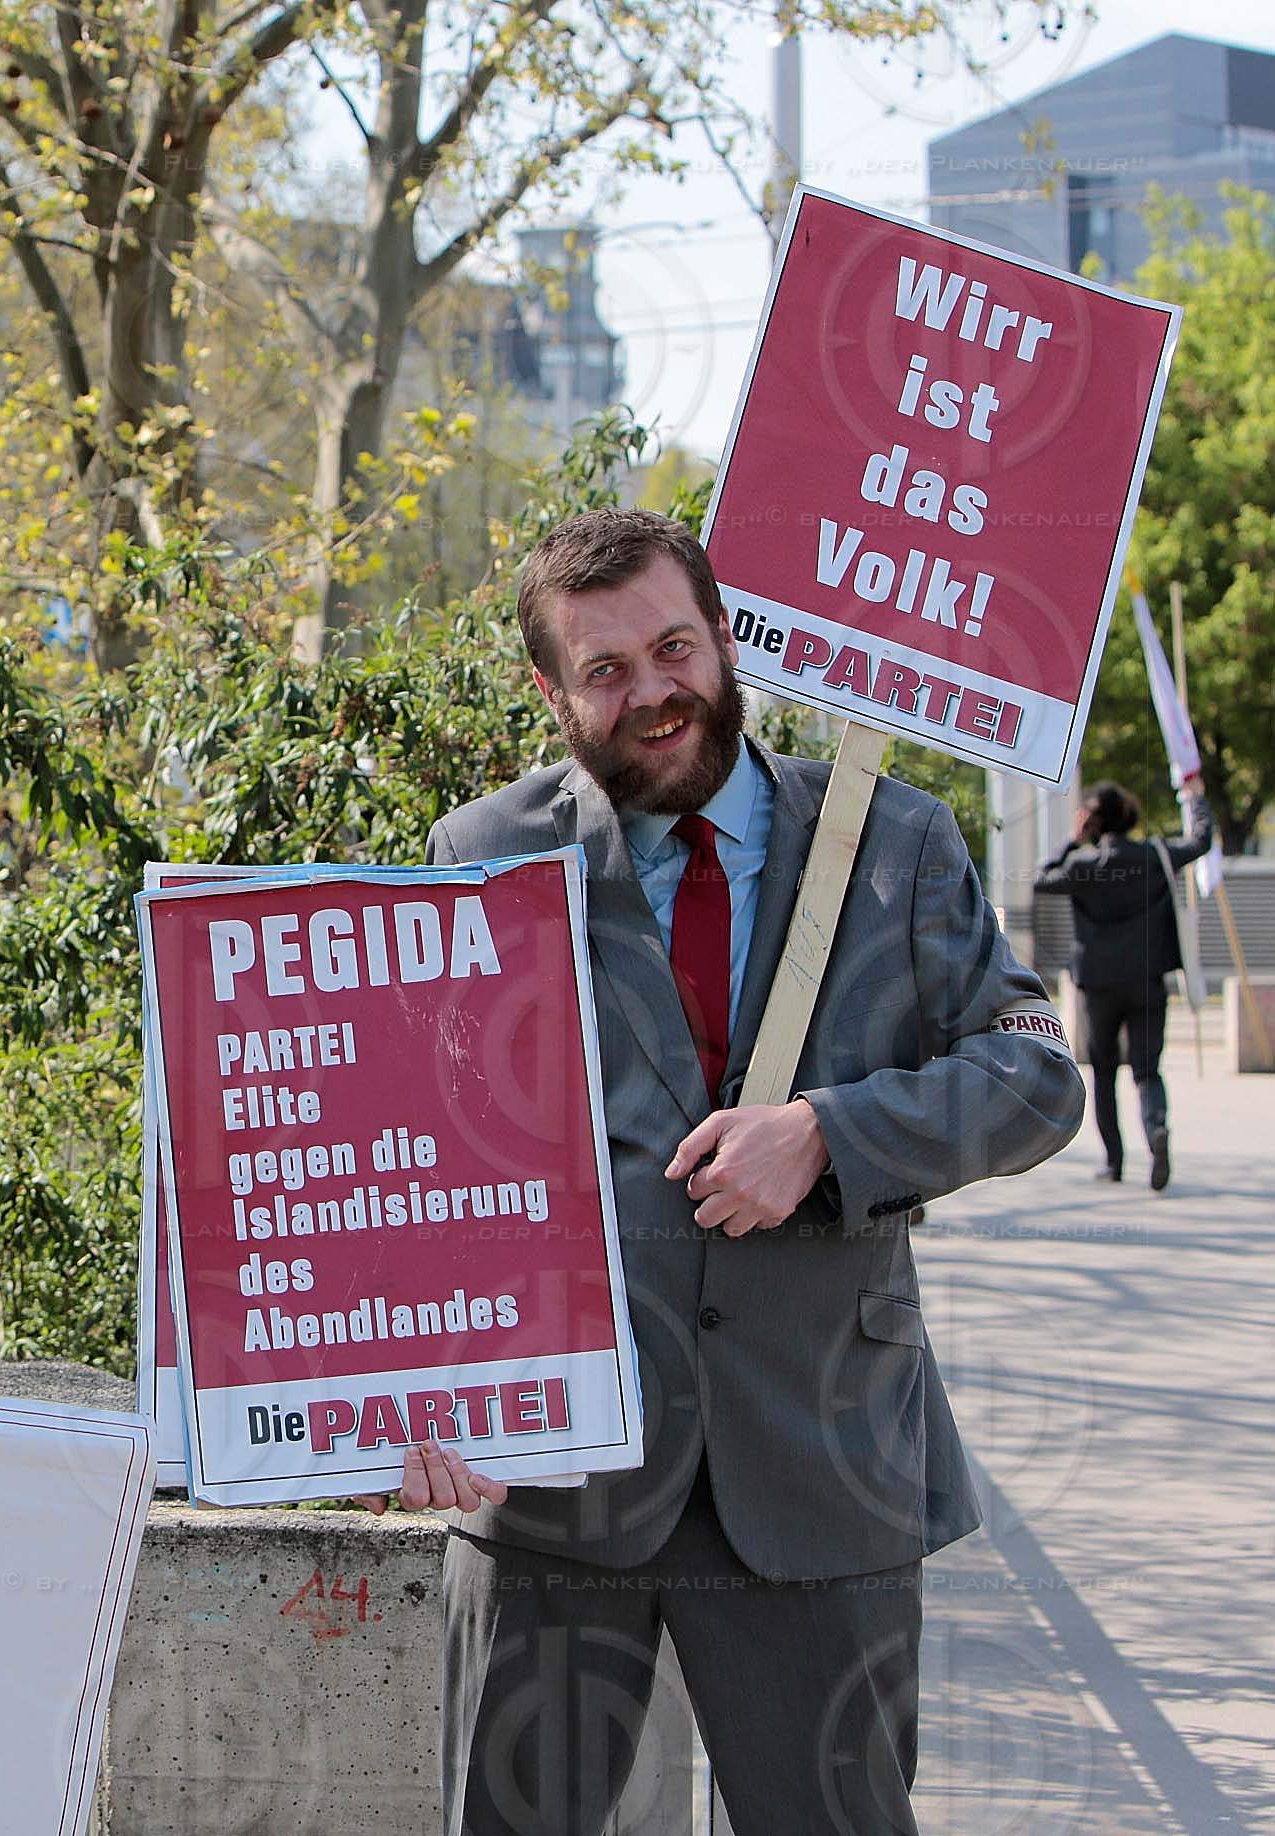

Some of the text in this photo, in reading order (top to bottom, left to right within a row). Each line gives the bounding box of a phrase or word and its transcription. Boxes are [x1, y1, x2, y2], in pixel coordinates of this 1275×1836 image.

[895, 256, 1053, 363] Wirr
[898, 356, 1000, 443] ist
[860, 445, 989, 536] das
[815, 518, 995, 637] Volk!
[732, 606, 1025, 748] Die PARTEI
[207, 895, 502, 1001] PEGIDA
[217, 1022, 357, 1076] PARTEI
[999, 1015, 1065, 1042] PARTEI
[222, 1087, 321, 1131] Elite
[229, 1128, 438, 1194] gegen die
[233, 1178, 549, 1241] Islandisierung
[239, 1253, 314, 1297] des
[244, 1289, 519, 1352] Abendlandes
[248, 1377, 570, 1453] Die PARTEI
